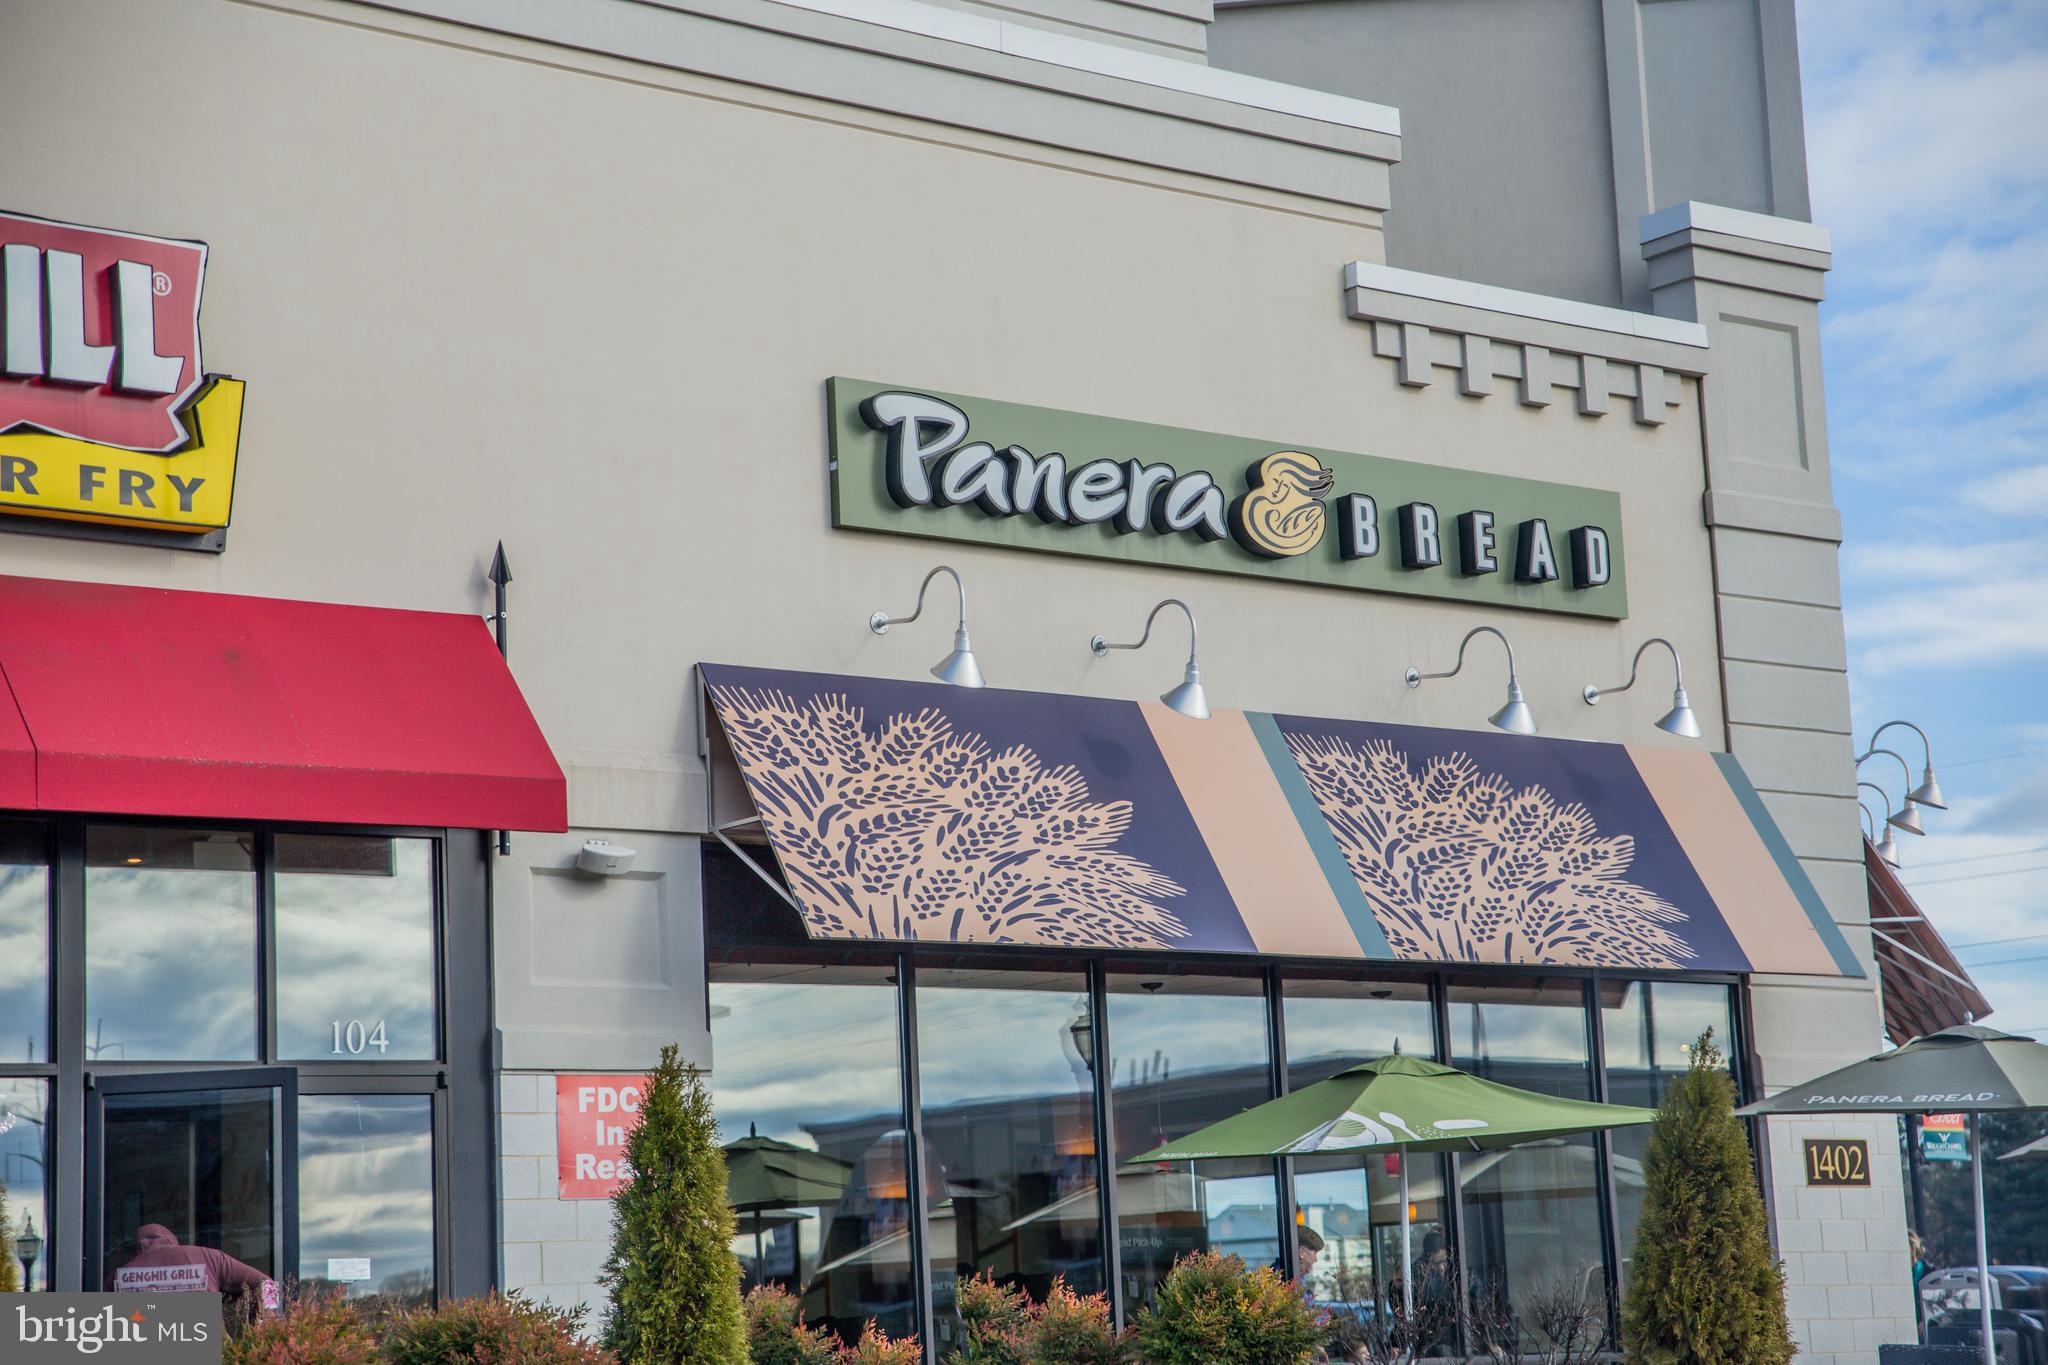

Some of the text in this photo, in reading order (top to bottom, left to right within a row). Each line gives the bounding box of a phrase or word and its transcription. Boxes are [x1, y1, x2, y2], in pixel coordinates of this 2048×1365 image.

[79, 464, 206, 513] FRY
[864, 391, 1611, 589] Panera BREAD
[331, 1019, 389, 1054] 104
[578, 1086, 639, 1113] FDC
[596, 1120, 625, 1146] In
[1810, 1145, 1865, 1181] 1402
[122, 1268, 201, 1283] GENGHIS GRILL
